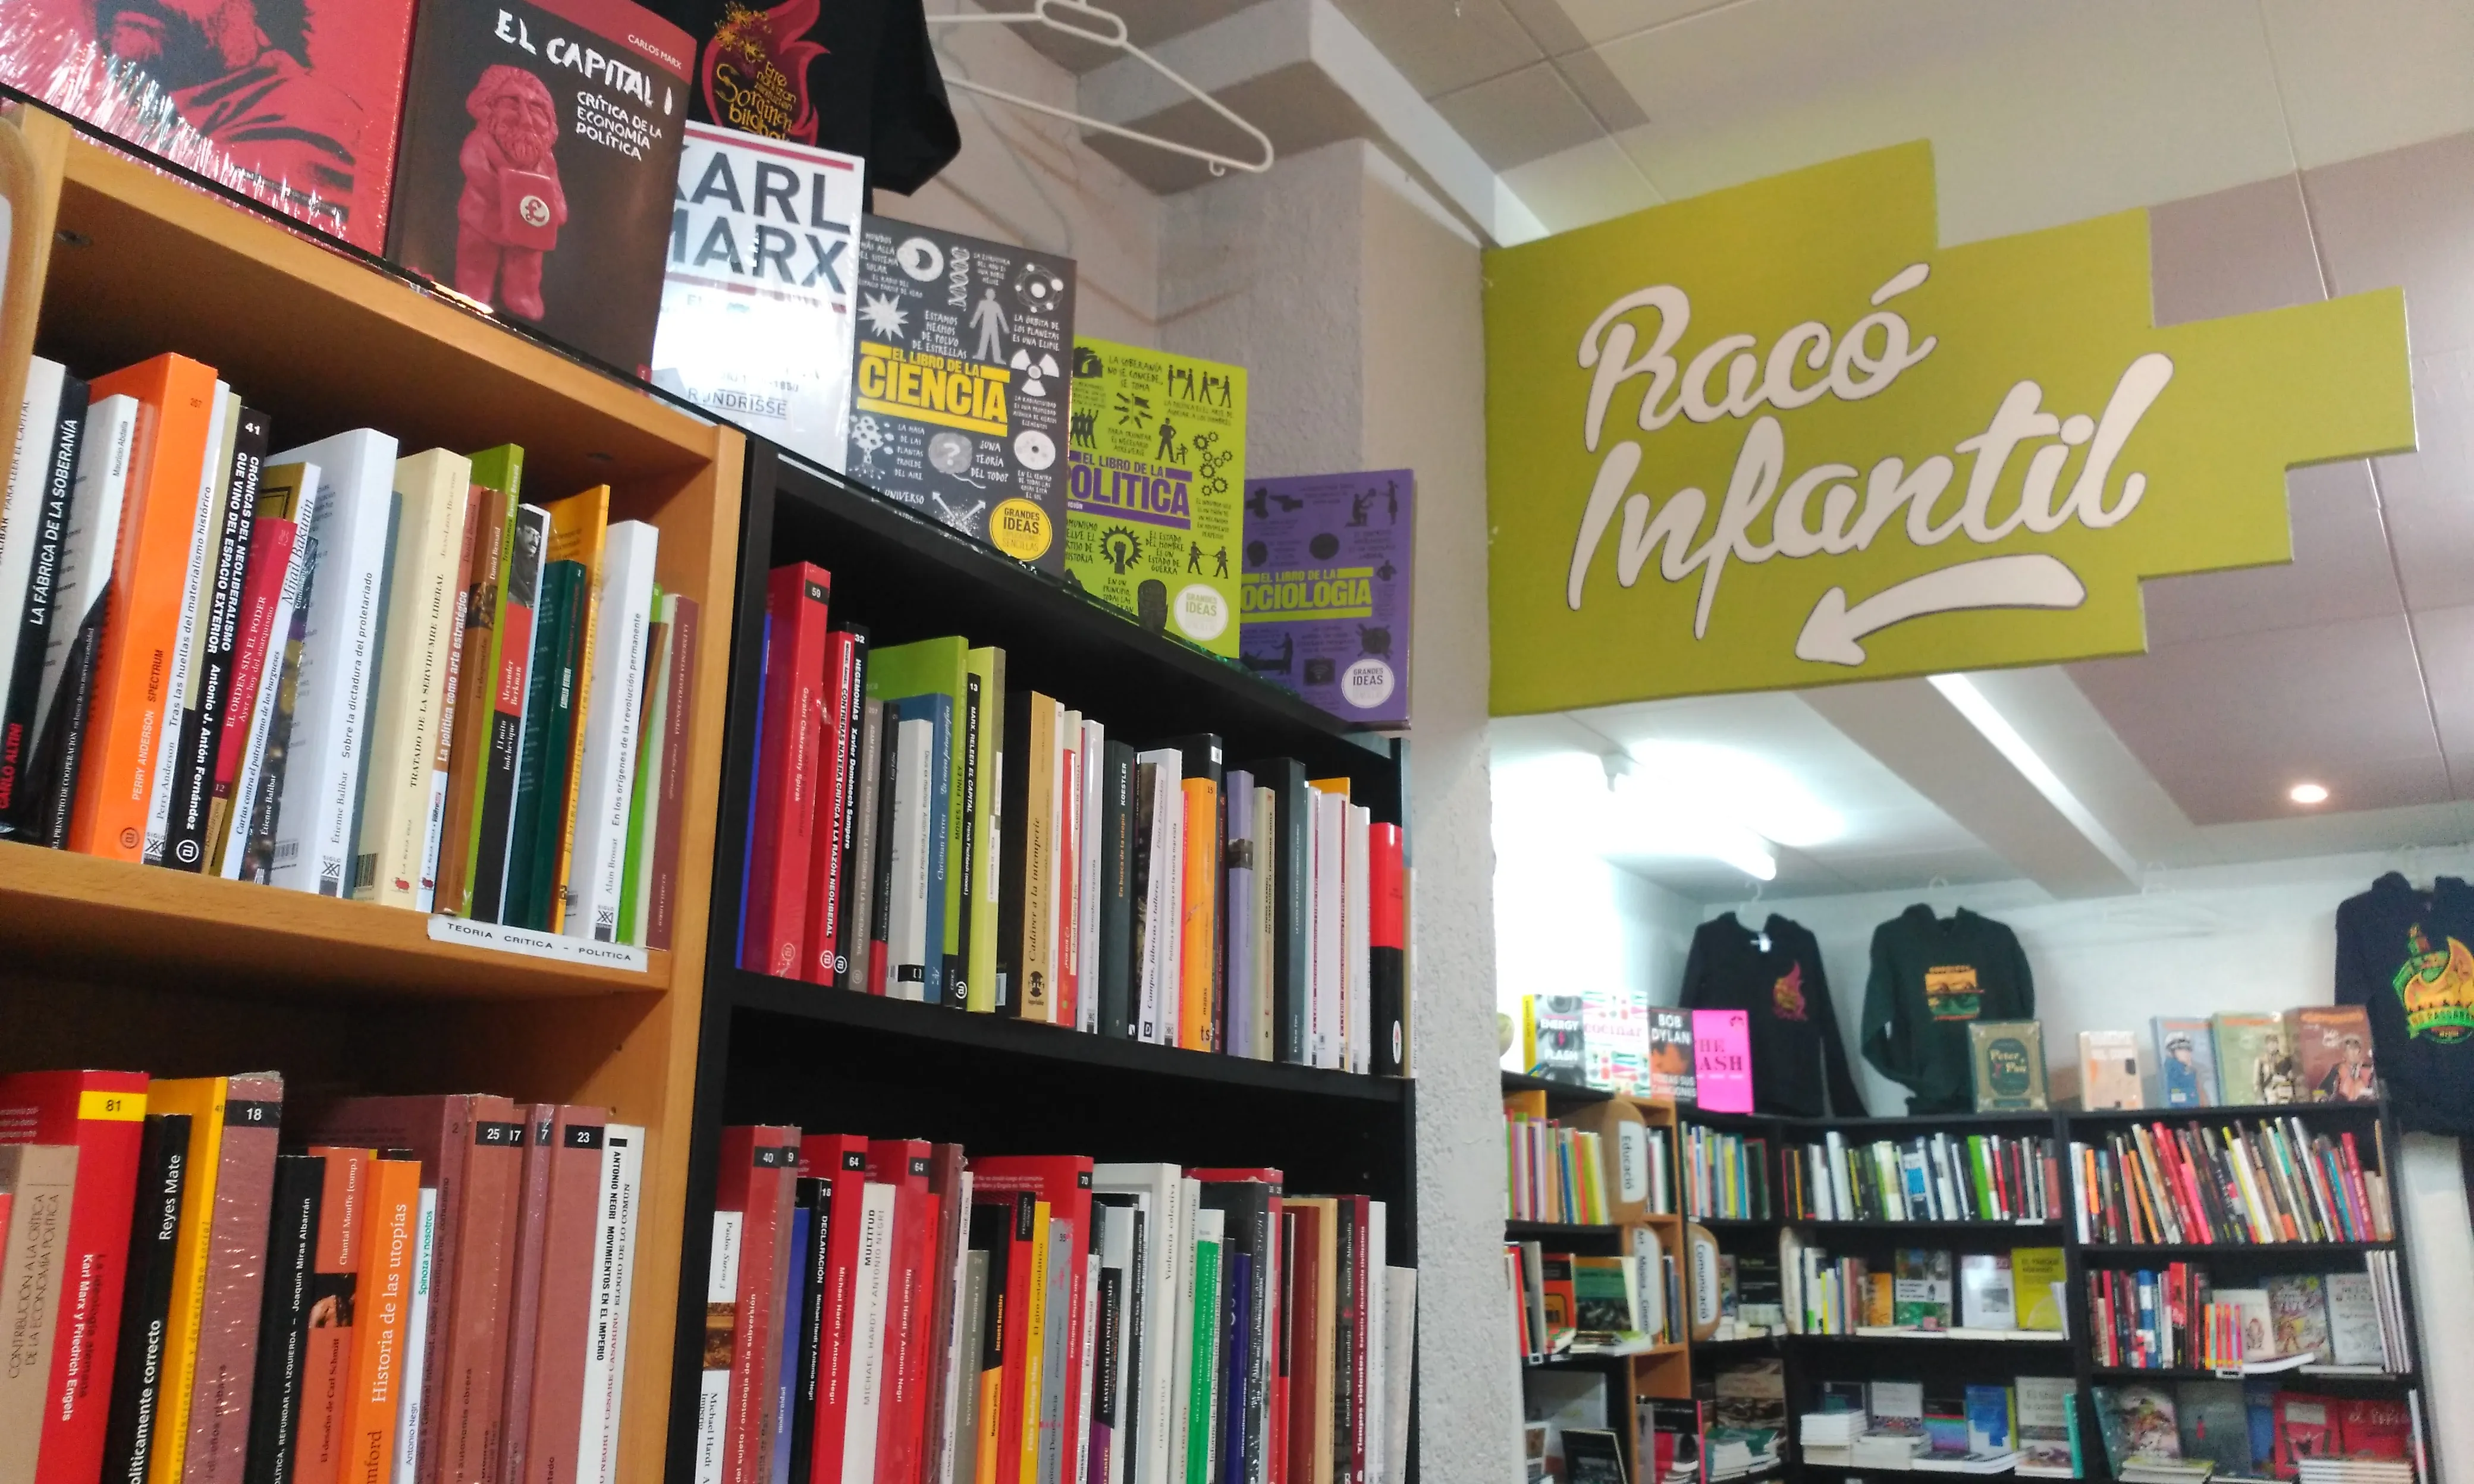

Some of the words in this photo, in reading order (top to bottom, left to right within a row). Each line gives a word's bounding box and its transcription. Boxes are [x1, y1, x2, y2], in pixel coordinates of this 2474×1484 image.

[494, 8, 536, 55] EL
[546, 37, 654, 108] CAPITAL
[627, 34, 660, 57] CARLOS
[660, 51, 682, 70] MARX
[576, 91, 629, 124] CRÍTICA
[632, 115, 647, 133] DE
[650, 124, 662, 139] LA
[577, 106, 650, 150] ECONOMÍA
[575, 122, 642, 162] POLÍTICA
[925, 310, 958, 326] ESTAMOS
[926, 322, 956, 335] HECHOS
[921, 332, 933, 341] DE
[934, 333, 959, 347] POLVO
[1014, 326, 1025, 334] LOS
[1027, 328, 1060, 341] PLANETAS
[891, 348, 907, 362] EL
[910, 351, 944, 369] LIBRO
[947, 358, 962, 371] DE
[964, 360, 981, 378] LA
[912, 339, 924, 349] DE
[926, 341, 968, 359] ESTRELLAS
[1578, 262, 1939, 454] Racó
[858, 356, 1008, 425] CIENCIA
[244, 422, 260, 436] 41
[49, 417, 77, 498] SOBERANÍA
[233, 452, 247, 477] QUE
[976, 454, 1004, 469] TEORÍA
[1082, 452, 1095, 466] EL
[1098, 456, 1131, 472] LIBRO
[1134, 461, 1148, 475] DE
[1150, 464, 1164, 478] LA
[240, 456, 261, 517] CRÓNICAS
[971, 467, 985, 480] DEL
[987, 470, 1009, 484] TODO?
[228, 480, 243, 508] VINO
[885, 488, 925, 505] UNIVERSO
[1070, 464, 1190, 518] OLITICA
[1566, 352, 2175, 642] Infantil
[48, 500, 63, 517] LA
[1004, 507, 1040, 521] GRANDES
[44, 520, 60, 540] DE
[225, 512, 238, 535] DEL
[237, 520, 250, 543] DEL
[290, 498, 315, 559] Bakunin
[1003, 516, 1040, 535] IDEAS
[30, 542, 56, 603] FÁBRICA
[216, 537, 235, 589] ESPACIO
[1259, 573, 1273, 583] EL
[1276, 570, 1305, 583] LIBRO
[1308, 570, 1320, 581] DE
[1323, 569, 1336, 580] LA
[281, 559, 302, 605] Mijail
[811, 587, 821, 599] 59
[1241, 578, 1373, 611] OCIOLOGIA
[220, 545, 246, 652] NEOLIBERALISMO
[356, 573, 373, 637] proletariado
[1185, 601, 1217, 617] IDEAS
[29, 605, 45, 625] LA
[207, 592, 227, 654] EXTERIOR
[451, 590, 469, 649] estratégico
[354, 641, 365, 656] del
[854, 633, 865, 644] 32
[448, 652, 461, 674] arte
[1353, 666, 1384, 675] GRANDES
[204, 664, 221, 710] Antonio
[347, 659, 362, 710] dictadura
[444, 678, 458, 704] como
[501, 660, 515, 702] Alexander
[510, 666, 523, 705] Berkman
[852, 659, 863, 720] HEGEMONÍAS
[969, 682, 978, 692] 13
[1352, 675, 1384, 686] IDEAS
[202, 712, 214, 724] J.
[346, 713, 355, 723] la
[439, 708, 454, 746] política
[196, 728, 212, 763] Antón
[341, 728, 353, 758] Sobre
[437, 749, 449, 762] La
[849, 727, 858, 756] Xavier
[186, 766, 206, 829] Fernández
[335, 771, 348, 804] Balibar
[1207, 786, 1214, 794] 15
[330, 807, 344, 844] Étienne
[843, 809, 853, 849] Sampere
[1031, 818, 1041, 881] intemperie
[1030, 885, 1040, 896] la
[447, 922, 494, 939] TEORIA
[504, 935, 553, 949] CRITICA
[578, 947, 632, 961] POLITICA
[1028, 913, 1038, 961] Cadáver
[1540, 1018, 1578, 1032] ENERGY
[1658, 1014, 1683, 1027] BOB
[1651, 1028, 1691, 1045] DYLAN
[1699, 1039, 1725, 1052] HE
[1699, 1056, 1743, 1071] ASH
[1990, 1049, 2020, 1061] Peter
[105, 1099, 121, 1112] 81
[246, 1107, 262, 1121] 18
[486, 1128, 500, 1140] 25
[576, 1131, 590, 1143] 23
[610, 1150, 621, 1189] ANTONIO
[763, 1152, 774, 1164] 40
[787, 1152, 794, 1162] 9
[849, 1156, 860, 1168] 64
[914, 1162, 924, 1172] 64
[1621, 1136, 1634, 1189] Educació
[163, 1155, 181, 1194] Mate
[1081, 1175, 1088, 1185] 70
[607, 1192, 617, 1219] NEGRI
[822, 1188, 831, 1197] 18
[1167, 1184, 1176, 1228] colectiva
[158, 1197, 177, 1241] Reyes
[422, 1211, 434, 1250] nosotros
[386, 1203, 409, 1268] utopías
[816, 1215, 828, 1282] DECLARACIÓN
[864, 1209, 875, 1265] MULTITUD
[1636, 1230, 1645, 1243] Art
[79, 1254, 93, 1277] Karl
[601, 1226, 615, 1289] MOVIMIENTOS
[1164, 1233, 1173, 1279] Violencia
[382, 1272, 401, 1297] las
[418, 1262, 430, 1295] Spinoza
[1695, 1244, 1709, 1318] Comunicació
[76, 1280, 89, 1310] Marx
[600, 1293, 609, 1304] EN
[74, 1312, 86, 1320] y
[379, 1301, 397, 1323] de
[599, 1308, 608, 1319] EL
[68, 1323, 84, 1376] Friedrich
[595, 1321, 607, 1360] IMPERIO
[371, 1326, 394, 1402] Historia
[62, 1379, 78, 1422] Engels
[408, 1403, 419, 1426] Negri
[707, 1392, 718, 1433] Michael
[404, 1430, 416, 1465] Antonio
[704, 1436, 714, 1467] Hardt
